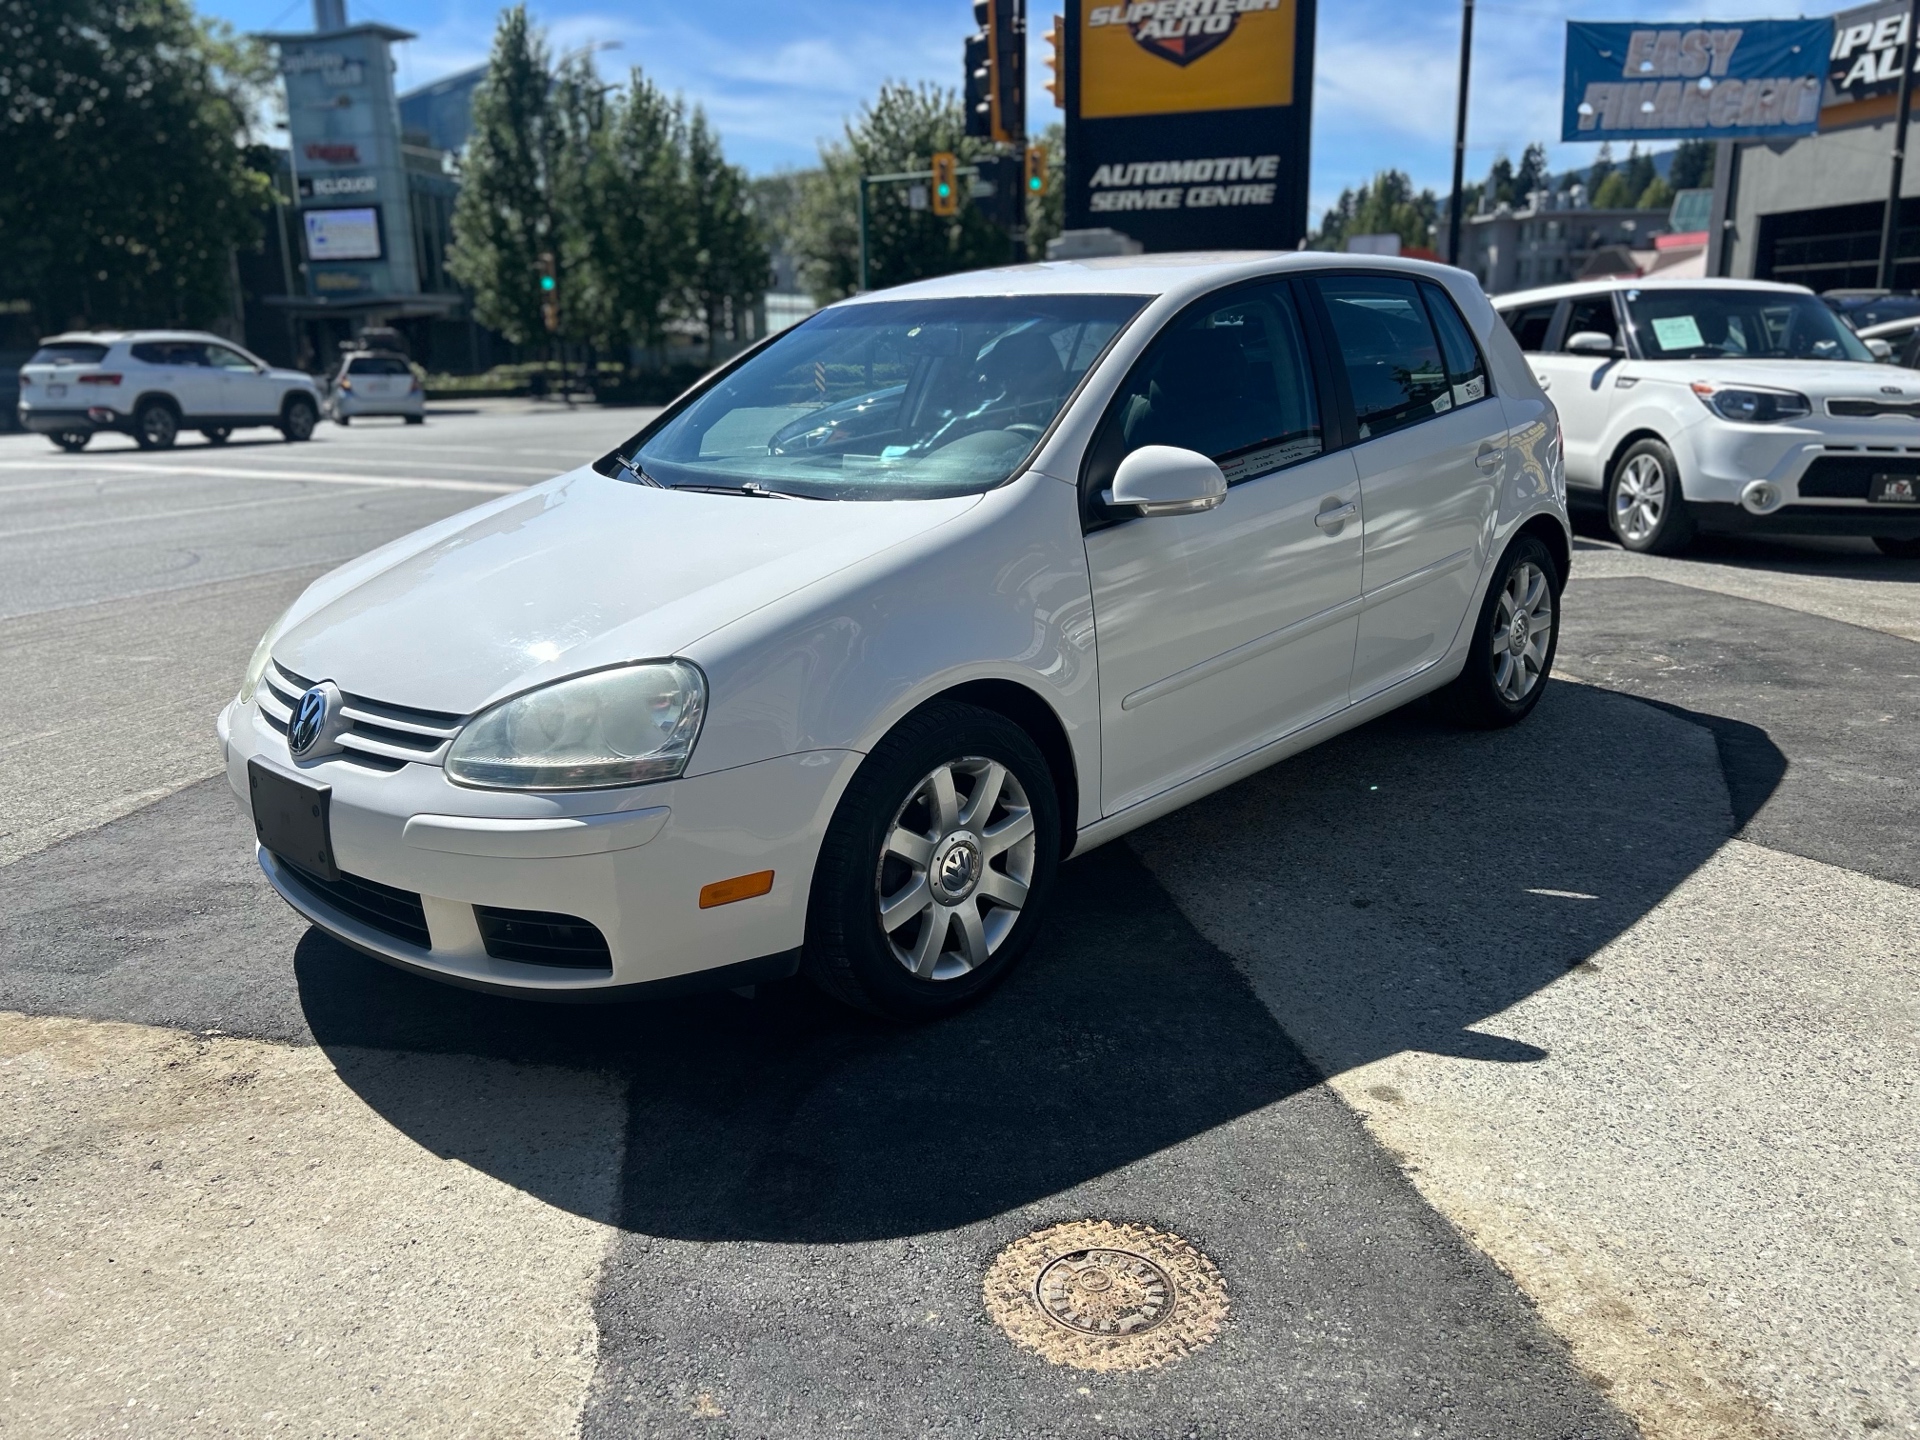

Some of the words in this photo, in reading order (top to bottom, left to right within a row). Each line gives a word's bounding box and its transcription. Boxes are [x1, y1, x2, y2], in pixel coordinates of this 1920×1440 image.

[1136, 14, 1232, 41] AUTO
[1622, 29, 1743, 78] EASY
[1089, 155, 1280, 188] AUTOMOTIVE
[1089, 187, 1184, 212] SERVICE
[1185, 183, 1277, 207] CENTRE
